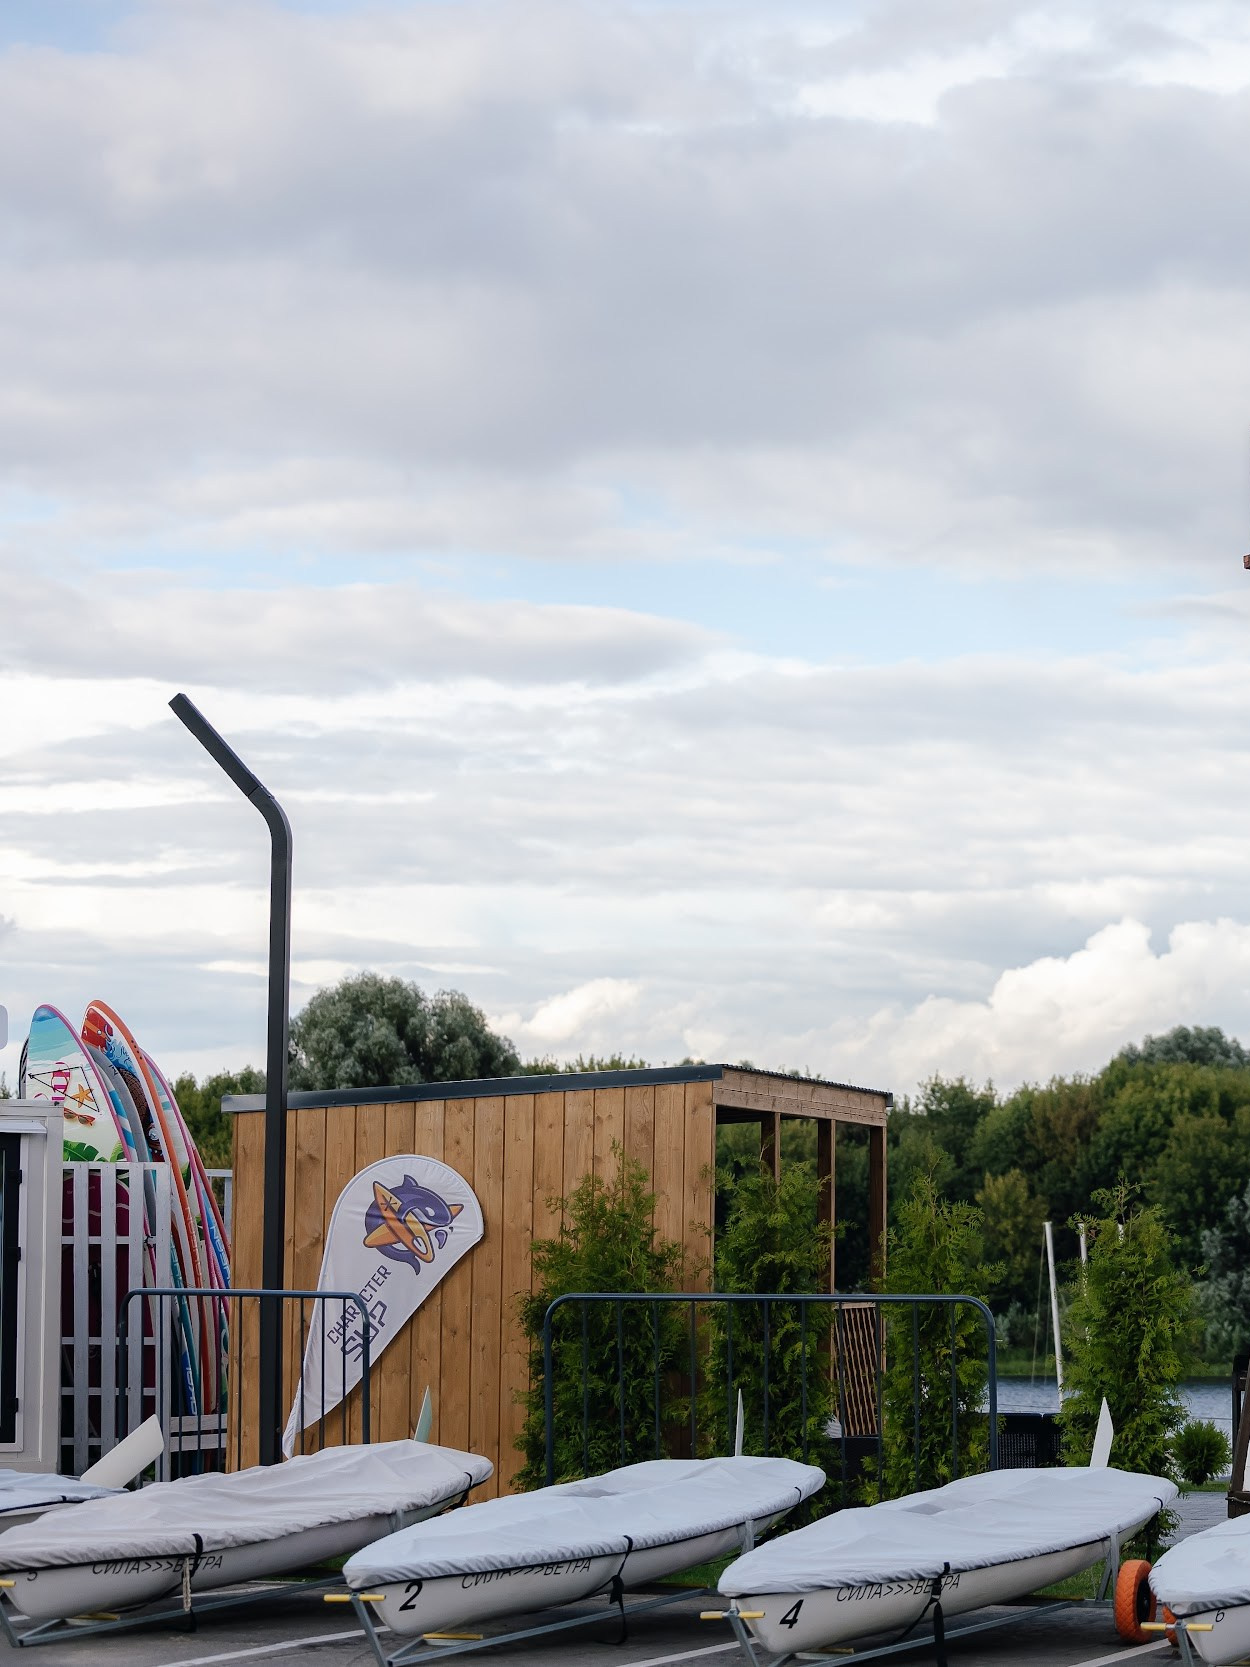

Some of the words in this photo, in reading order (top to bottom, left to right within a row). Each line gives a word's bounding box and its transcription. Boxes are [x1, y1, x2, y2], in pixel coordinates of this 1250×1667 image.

[326, 1264, 392, 1345] CHARCTER
[399, 1580, 424, 1612] 2
[779, 1598, 805, 1629] 4
